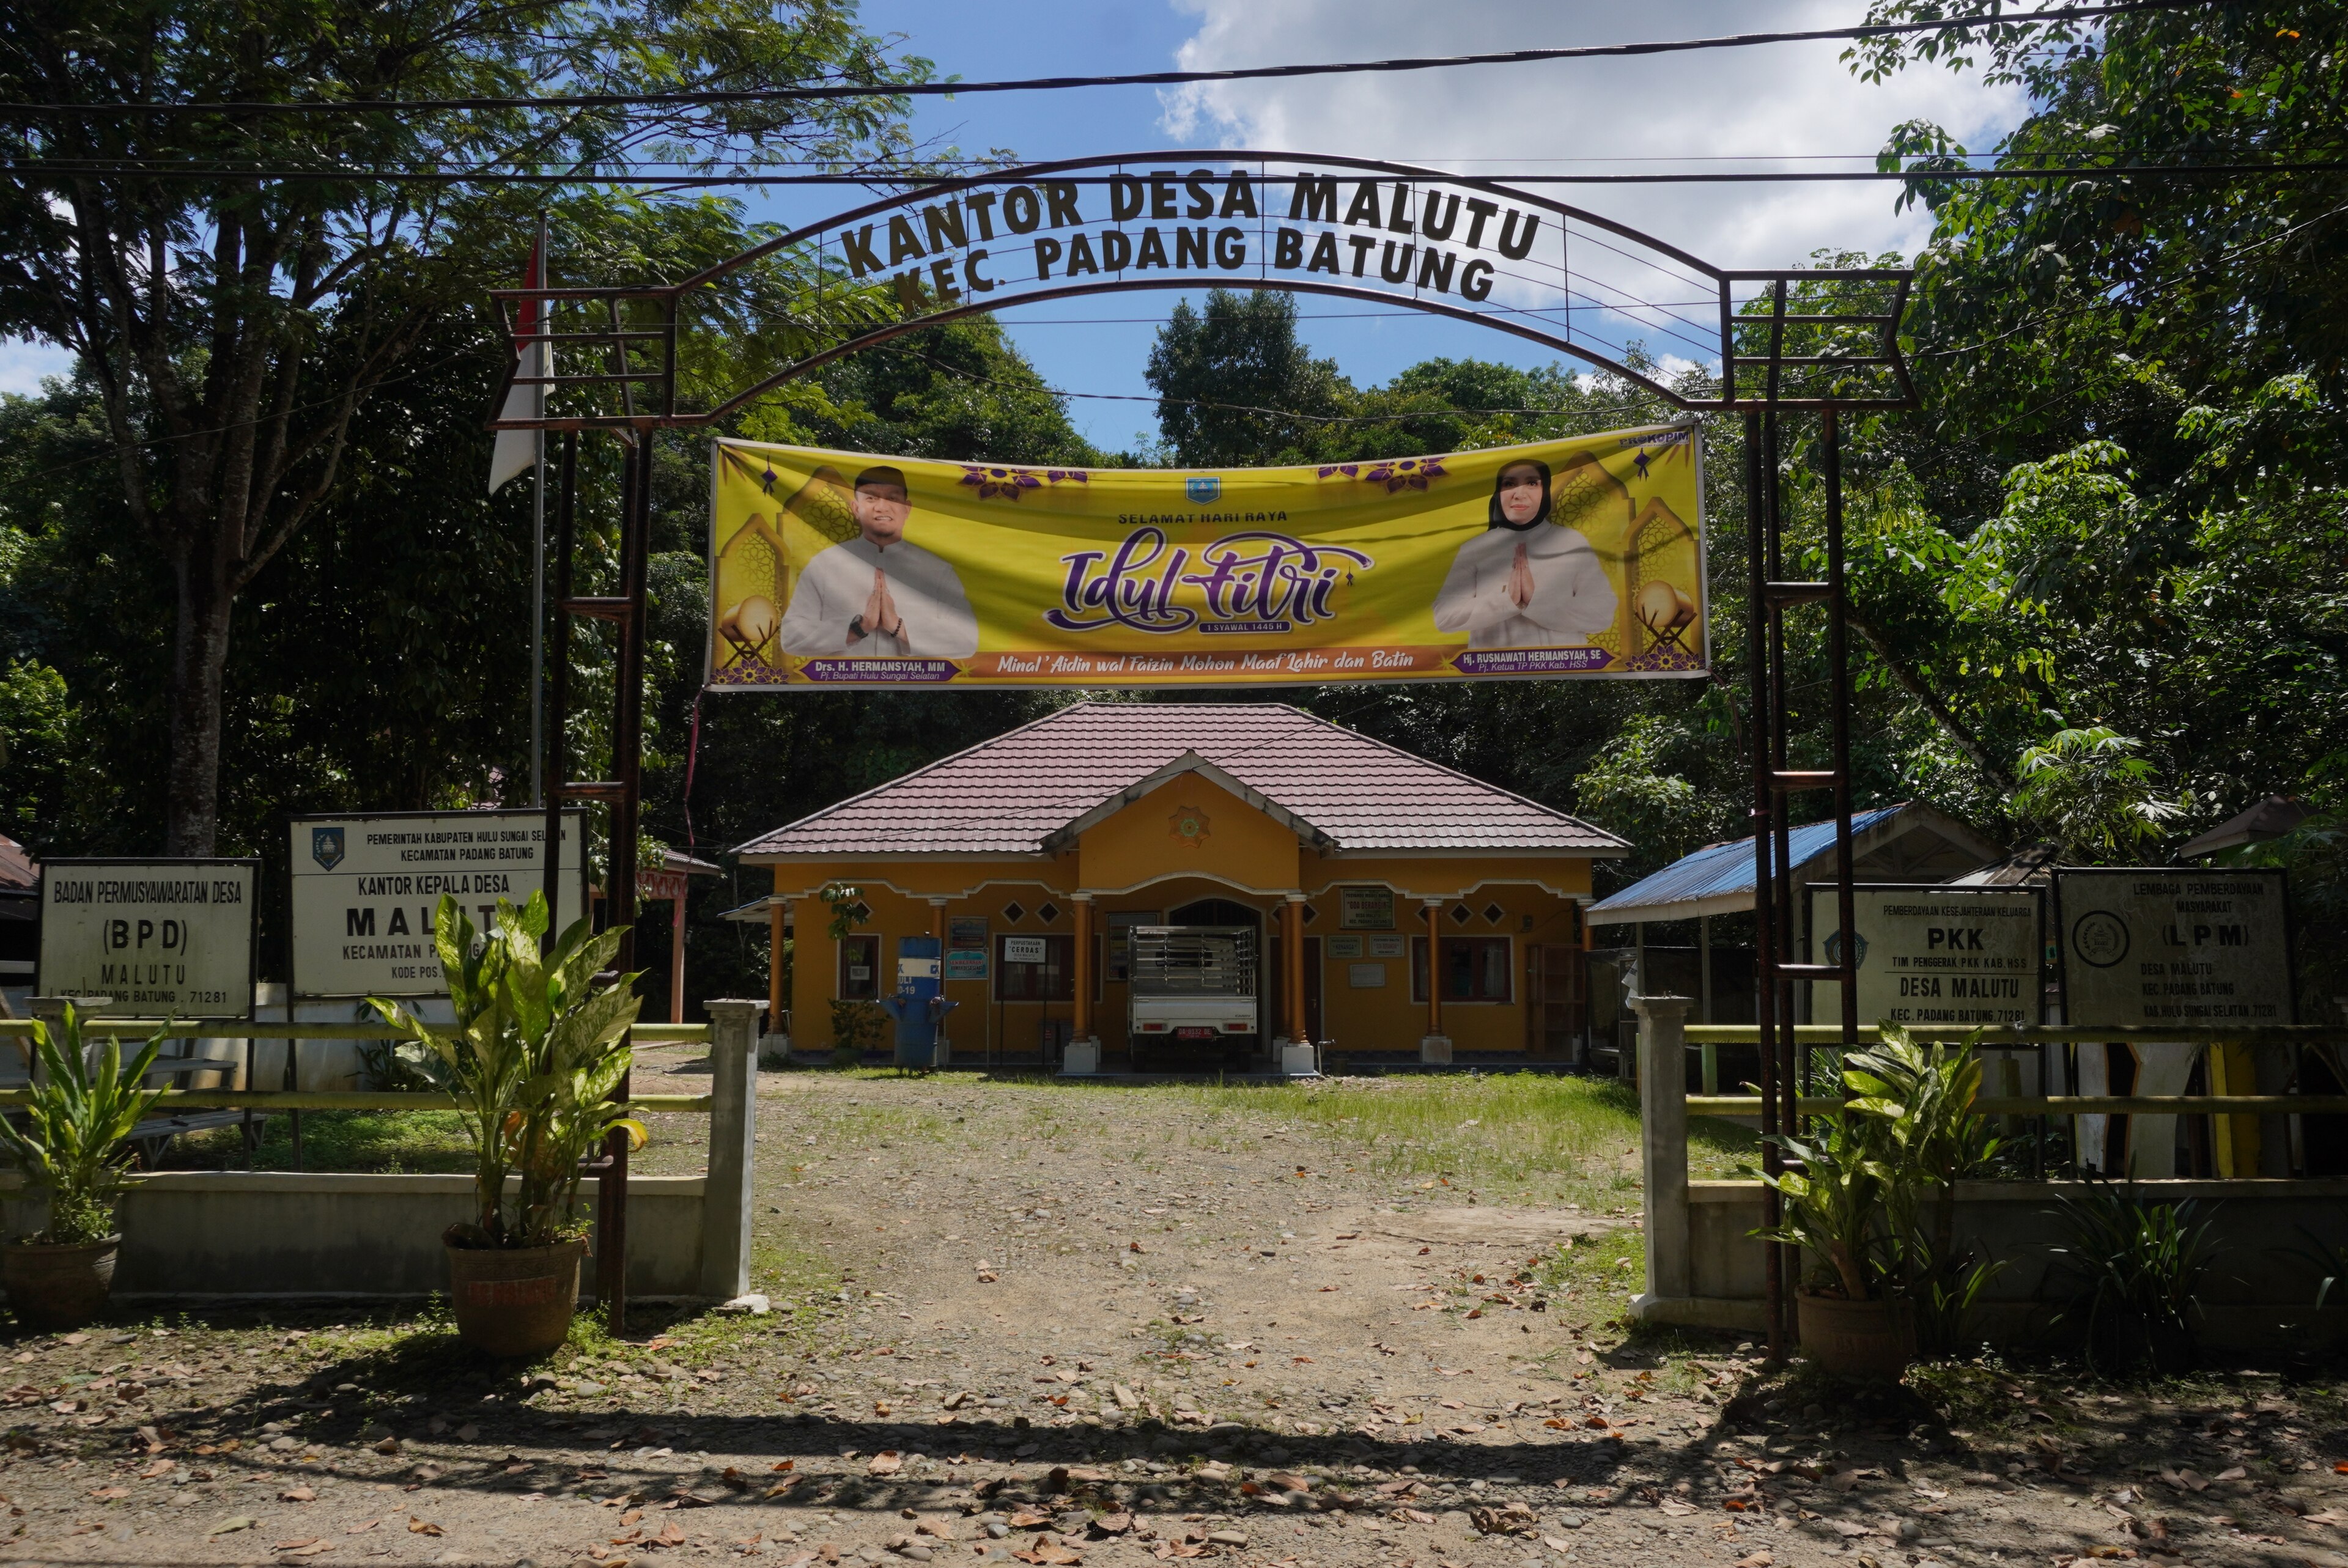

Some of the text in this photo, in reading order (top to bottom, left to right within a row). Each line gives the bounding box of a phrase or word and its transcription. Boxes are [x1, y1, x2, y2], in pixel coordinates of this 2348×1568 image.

[840, 169, 1541, 278] KANTOR DESA MALUTU
[893, 226, 1496, 314] KEC. PADANG BATUNG
[1118, 510, 1287, 524] SELAMAT HARI RAYA
[1043, 526, 1197, 632] Idul
[997, 655, 1041, 672] Minal
[1096, 656, 1126, 672] wal
[1130, 657, 1174, 672] Faizin
[1180, 655, 1234, 671] Mohon
[1241, 652, 1287, 670] Maaf
[1287, 652, 1328, 672] Lahir
[1334, 652, 1365, 668] dan
[1372, 650, 1414, 668] Batin
[1463, 649, 1601, 665] Hj. RUSNAWATI HERMANSYAH, SE
[815, 661, 945, 673] Drs. H. HERMANSYAH, MM
[1479, 660, 1588, 673] Pj. Ketua TP PKK Kab. HSS
[820, 671, 940, 682] Pj. Bupati Hulu Sungai Selatan
[367, 830, 566, 845] PEMERINTAH KABUPATEN HULU SUNGAI SELN
[401, 847, 533, 861] KECAMATAN PADANG BATUNG
[54, 881, 241, 904] BADAN PERMUSYAWARATAN DESA
[358, 875, 510, 896] KANTOR KEPALA DESA
[2133, 883, 2264, 896] LEMBAGA PEMBERDAYAAN
[1883, 905, 2031, 917] PEMBERDAYAAN KESEJAHTERAAN KELUARGA
[2177, 901, 2232, 913] MASYARAKAT
[346, 904, 525, 937] MALT
[1927, 928, 1984, 951] PKK
[342, 944, 421, 960] KECAMATAN
[1892, 957, 1908, 966] TIM
[1913, 957, 1957, 967] PENGGERAK
[1961, 957, 1979, 968] PKK
[2141, 963, 2212, 975] DESA MALUTU
[102, 964, 185, 985] MALUTU
[392, 966, 416, 979] KODE
[1900, 977, 2019, 998] DESA MALUTU
[2201, 982, 2234, 995] BATUNG
[87, 990, 129, 1003] PADANG
[134, 990, 175, 1003] BATUNG
[190, 992, 226, 1003] 71281
[1891, 1009, 1914, 1021] KEC.
[1917, 1009, 1955, 1021] PADANG
[2184, 1005, 2212, 1017] SUNGAI
[2213, 1005, 2250, 1017] SELATAN
